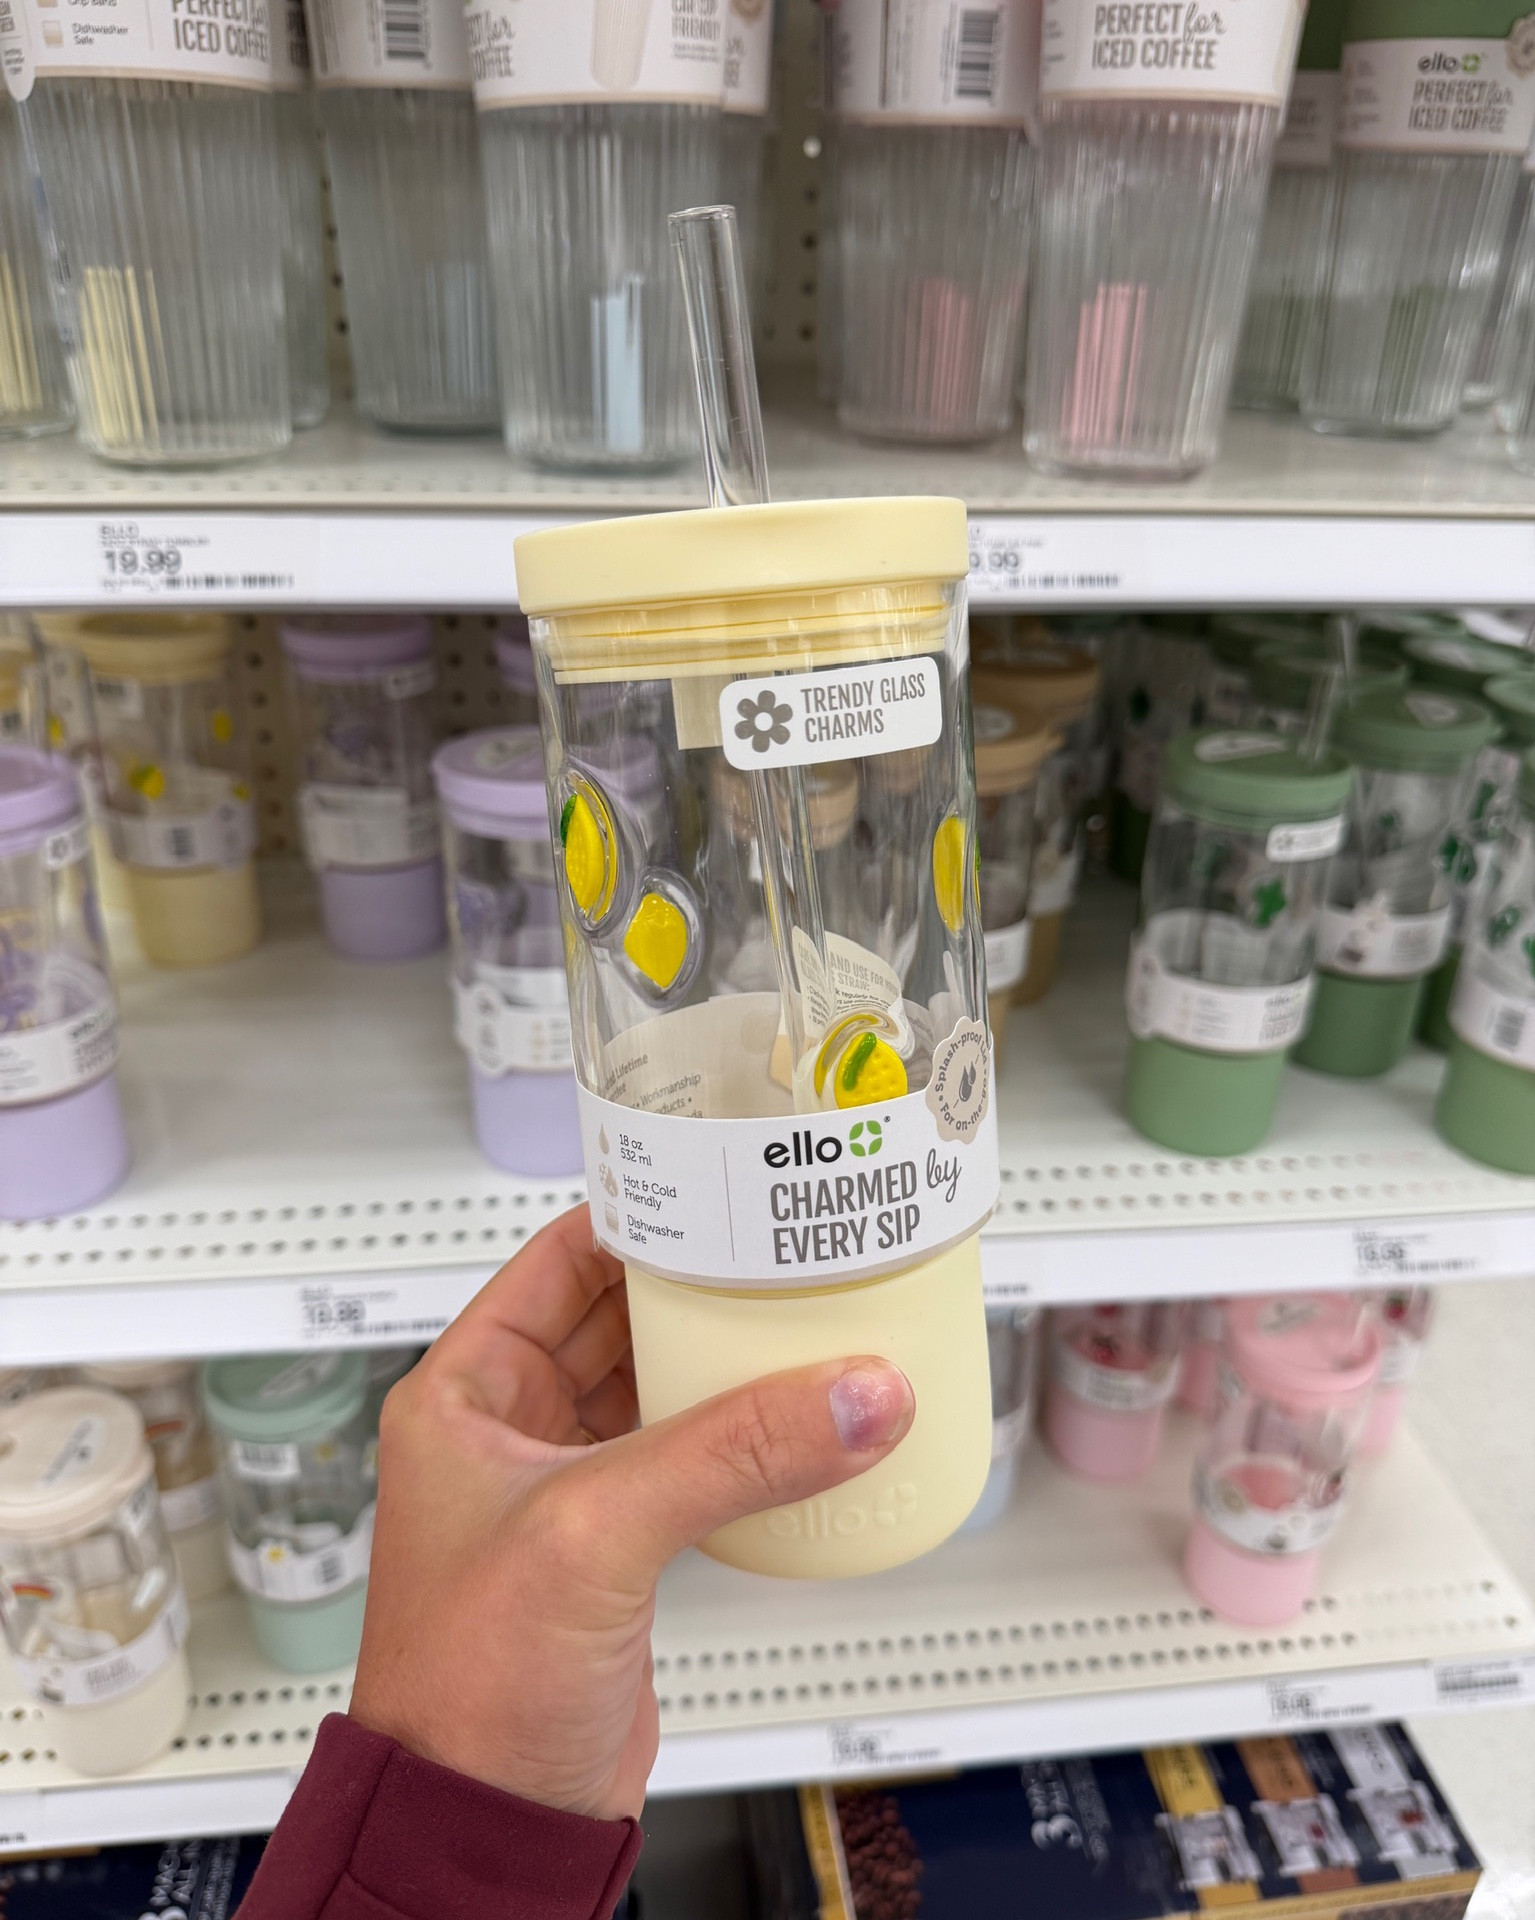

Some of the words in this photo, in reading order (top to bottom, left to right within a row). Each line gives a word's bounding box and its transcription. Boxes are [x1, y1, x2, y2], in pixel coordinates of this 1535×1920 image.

[1094, 3, 1183, 35] PERFECT
[1182, 1, 1226, 42] for
[174, 18, 221, 53] ICED
[1091, 38, 1135, 69] ICED
[1140, 39, 1217, 70] COFFEE
[1417, 51, 1459, 74] ello
[1413, 79, 1487, 103] PERFECT
[1407, 105, 1448, 132] ICED
[103, 549, 183, 576] 19.99
[800, 680, 874, 714] TRENDY
[880, 673, 926, 703] GLASS
[804, 708, 885, 743] CHARMS
[829, 951, 851, 974] AND
[853, 962, 869, 982] USE
[614, 1054, 649, 1079] Lifetime
[640, 1073, 702, 1107] Workmanship
[940, 1102, 955, 1126] For
[619, 1134, 630, 1146] 18
[631, 1139, 644, 1151] oz
[763, 1130, 843, 1169] ello
[620, 1147, 637, 1163] 532
[638, 1154, 653, 1167] ml
[623, 1174, 640, 1192] Hot
[641, 1180, 649, 1192] &
[651, 1182, 677, 1199] Cold
[770, 1160, 917, 1222] CHARMED
[926, 1148, 962, 1203] by
[624, 1189, 662, 1211] Friendly
[627, 1214, 685, 1240] Dishwasher
[628, 1228, 648, 1245] Safe
[773, 1215, 868, 1265] EVERY
[876, 1203, 920, 1250] SIP
